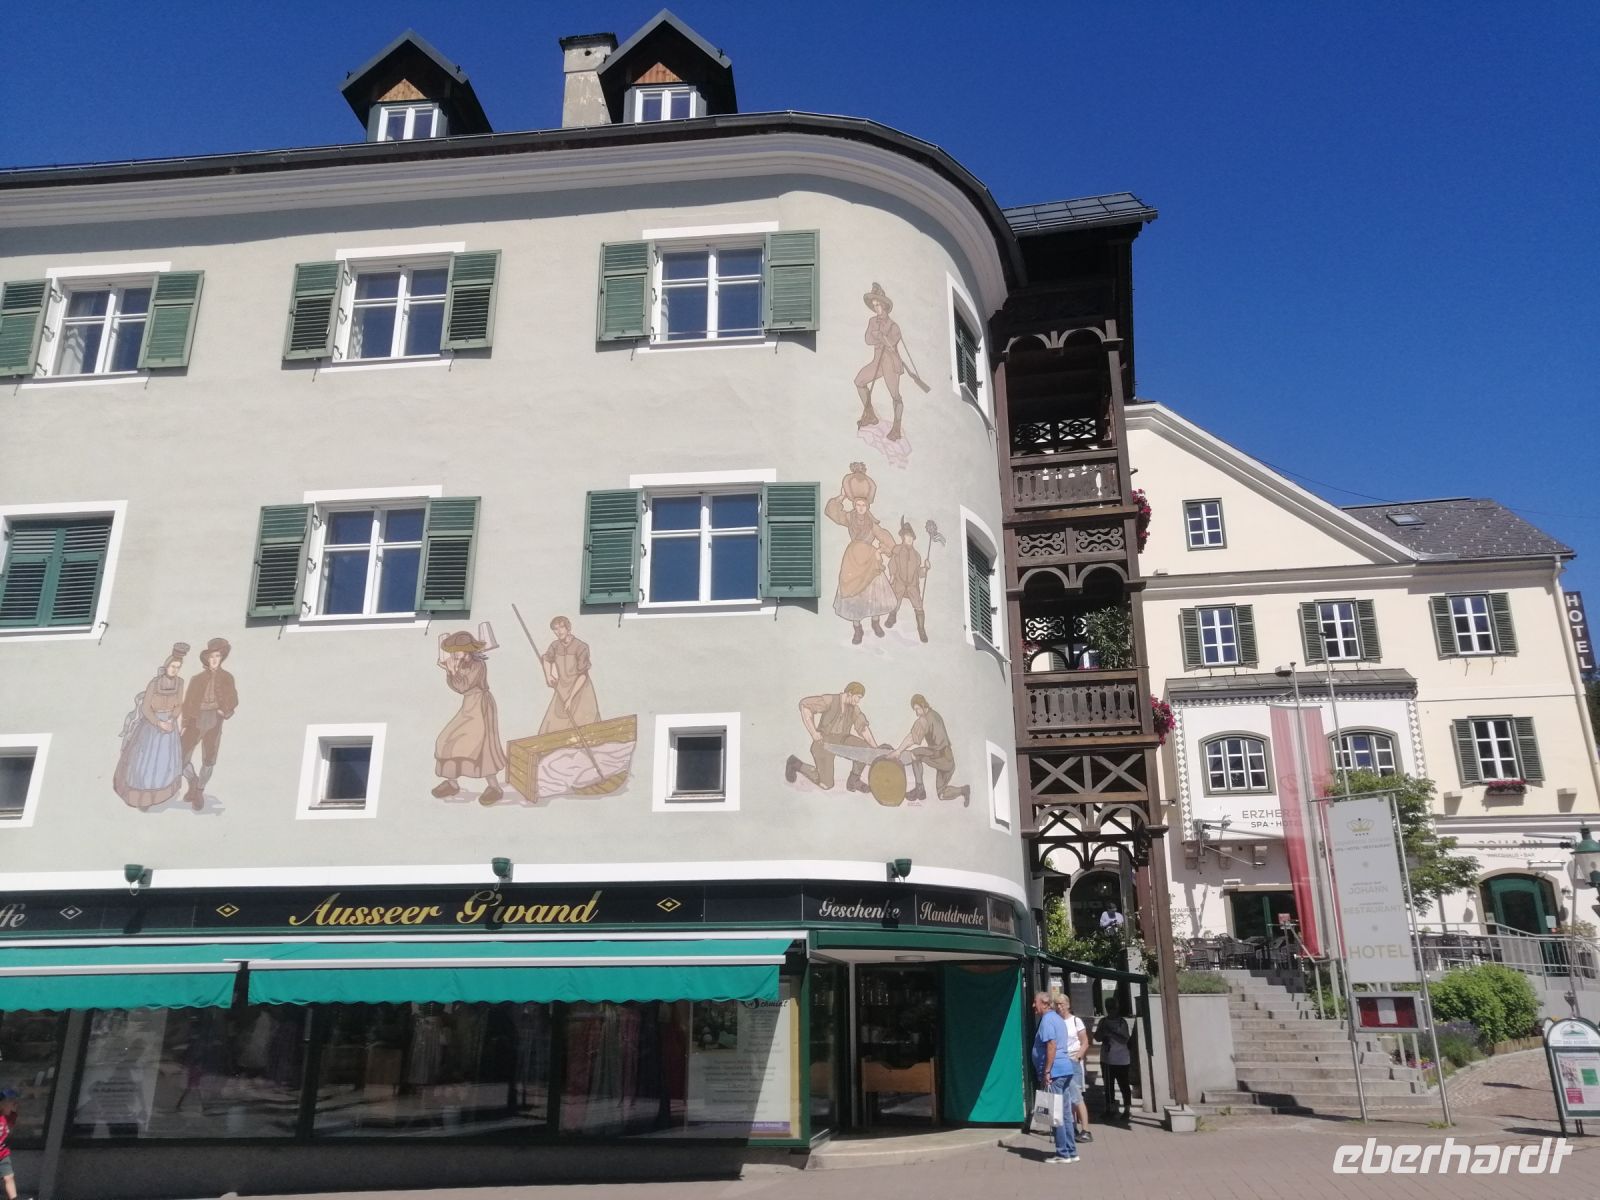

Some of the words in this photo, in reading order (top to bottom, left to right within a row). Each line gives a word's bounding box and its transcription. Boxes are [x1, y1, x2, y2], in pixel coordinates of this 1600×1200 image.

[1565, 594, 1592, 669] HOTEL
[1251, 820, 1268, 828] SPA
[288, 892, 442, 926] Ausseer
[818, 897, 901, 919] Geschenke
[1349, 944, 1410, 959] HOTEL
